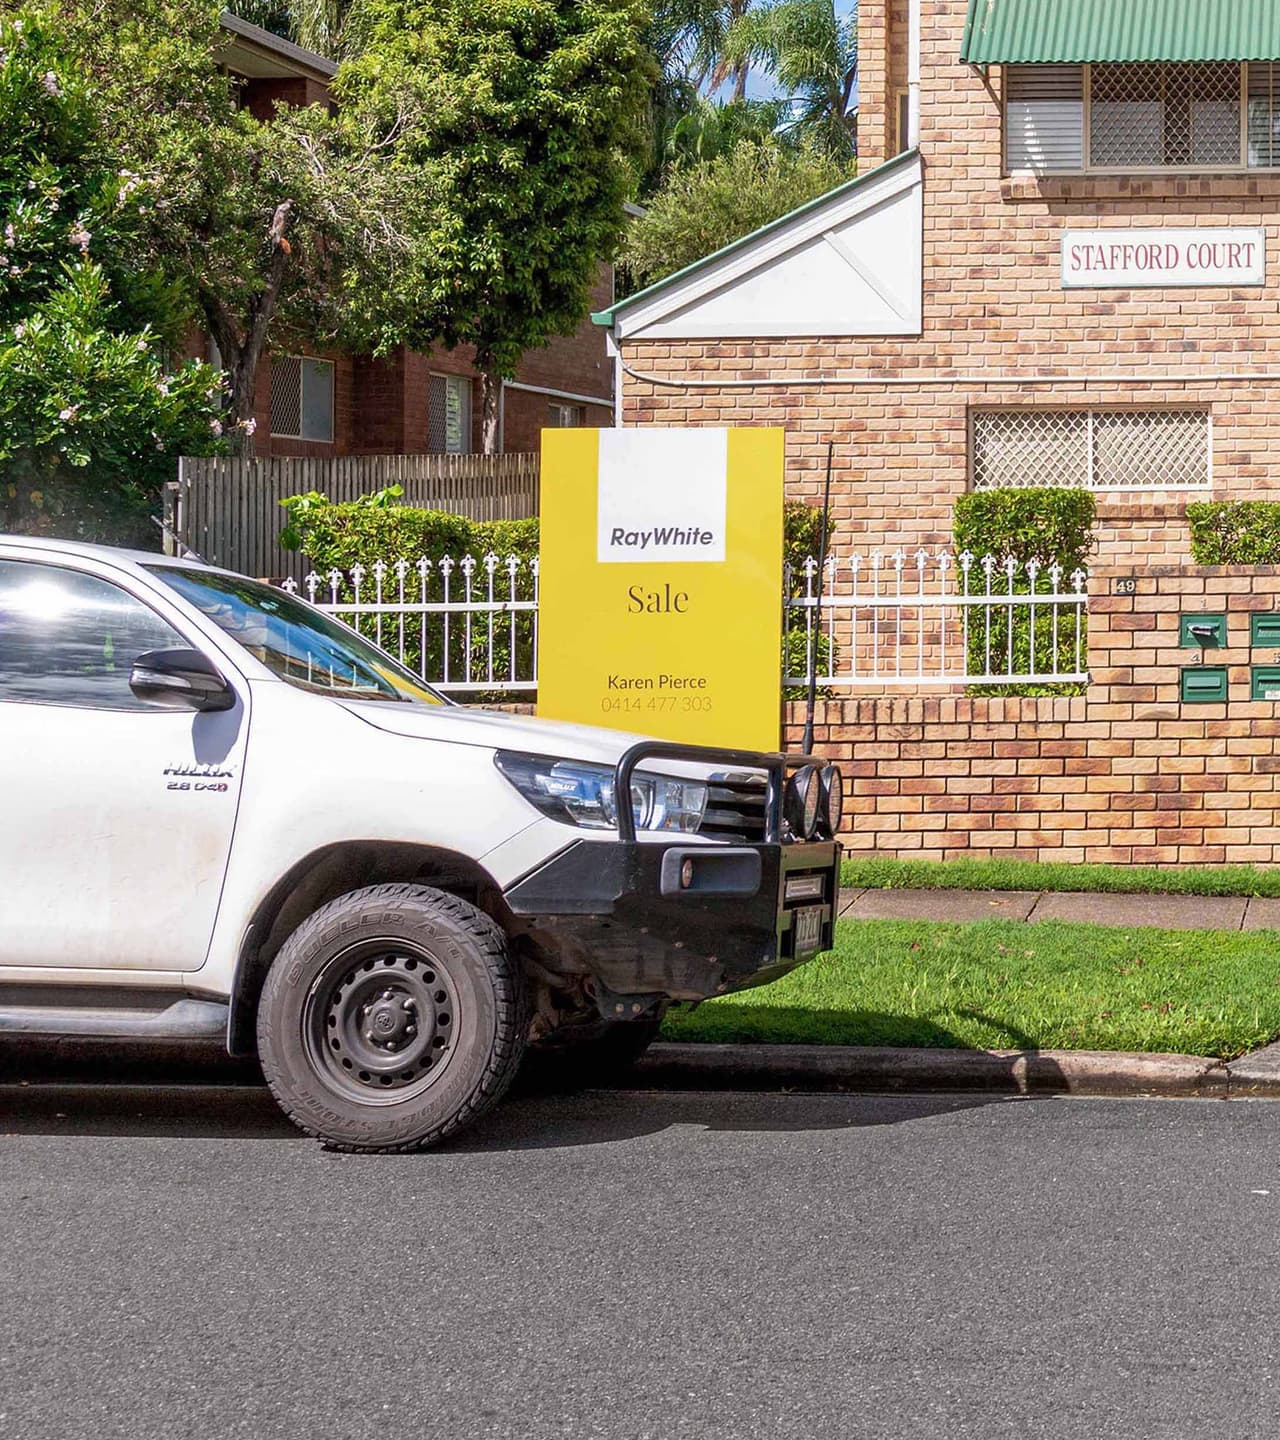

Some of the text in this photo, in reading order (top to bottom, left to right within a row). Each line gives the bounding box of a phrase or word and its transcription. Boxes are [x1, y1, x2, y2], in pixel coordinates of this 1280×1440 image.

[1071, 242, 1256, 271] STAFFORD COURT
[610, 527, 713, 550] RayWhite
[627, 583, 689, 614] Sale
[608, 674, 707, 690] Karen Pierce
[601, 696, 712, 712] 0414 477 303
